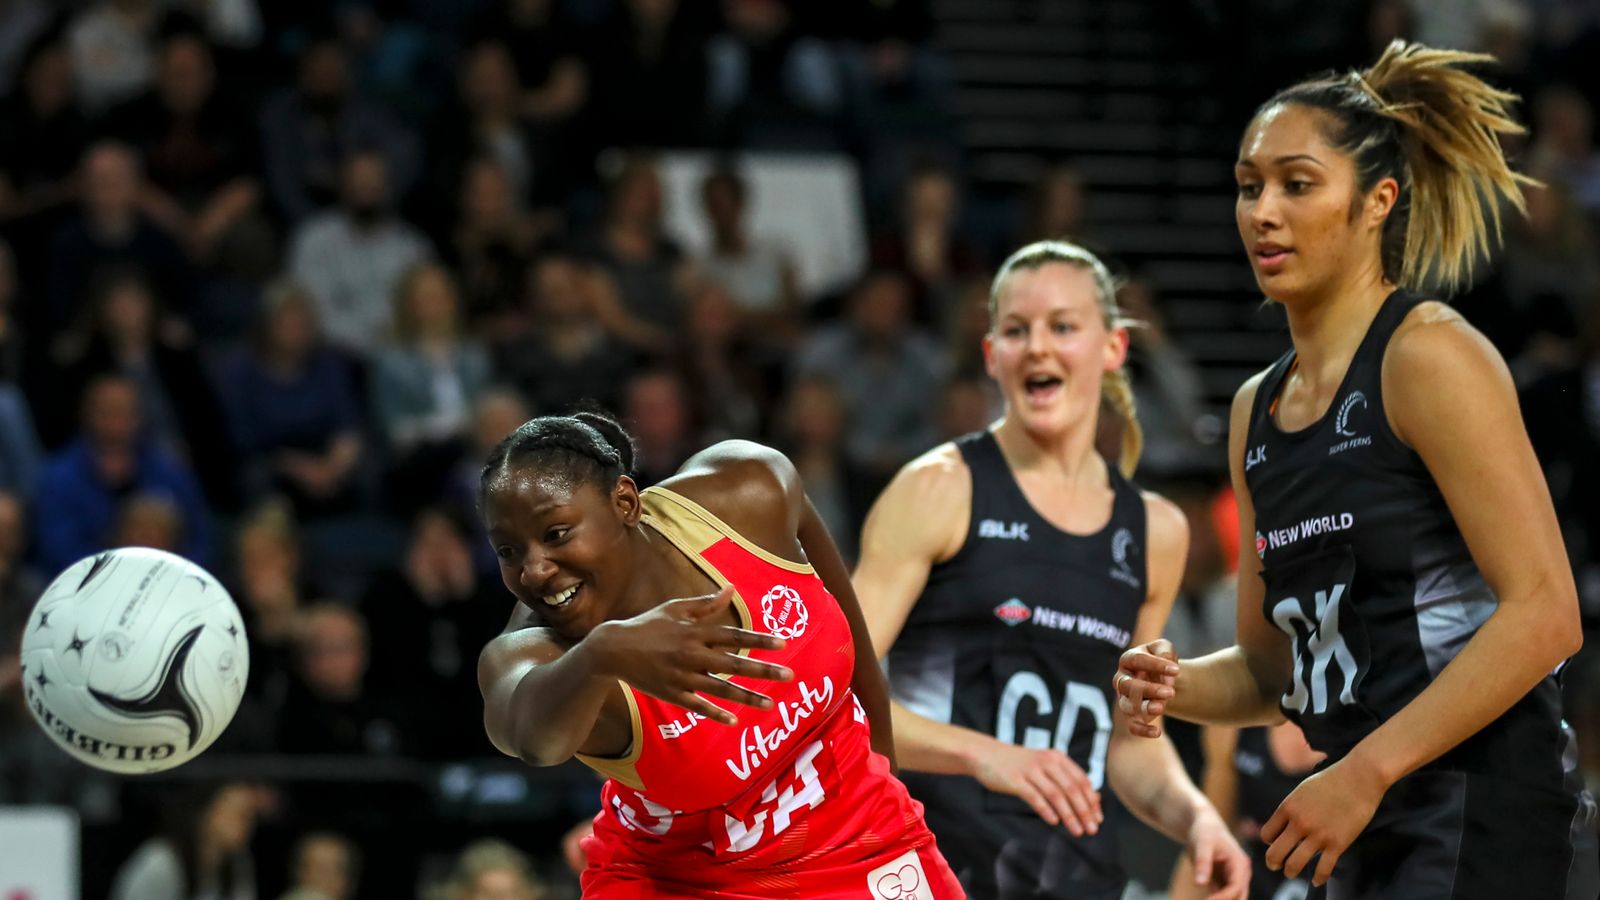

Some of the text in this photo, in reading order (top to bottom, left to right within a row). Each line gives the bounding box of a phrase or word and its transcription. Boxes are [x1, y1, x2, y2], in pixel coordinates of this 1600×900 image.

[1246, 444, 1266, 471] LK
[978, 519, 1030, 541] BLK
[1268, 512, 1353, 550] NEW WORLD
[777, 599, 793, 625] ENGLAND
[1032, 605, 1076, 630] NEW
[1077, 614, 1131, 649] WORLD
[726, 675, 834, 781] Vitality
[996, 670, 1113, 791] GD
